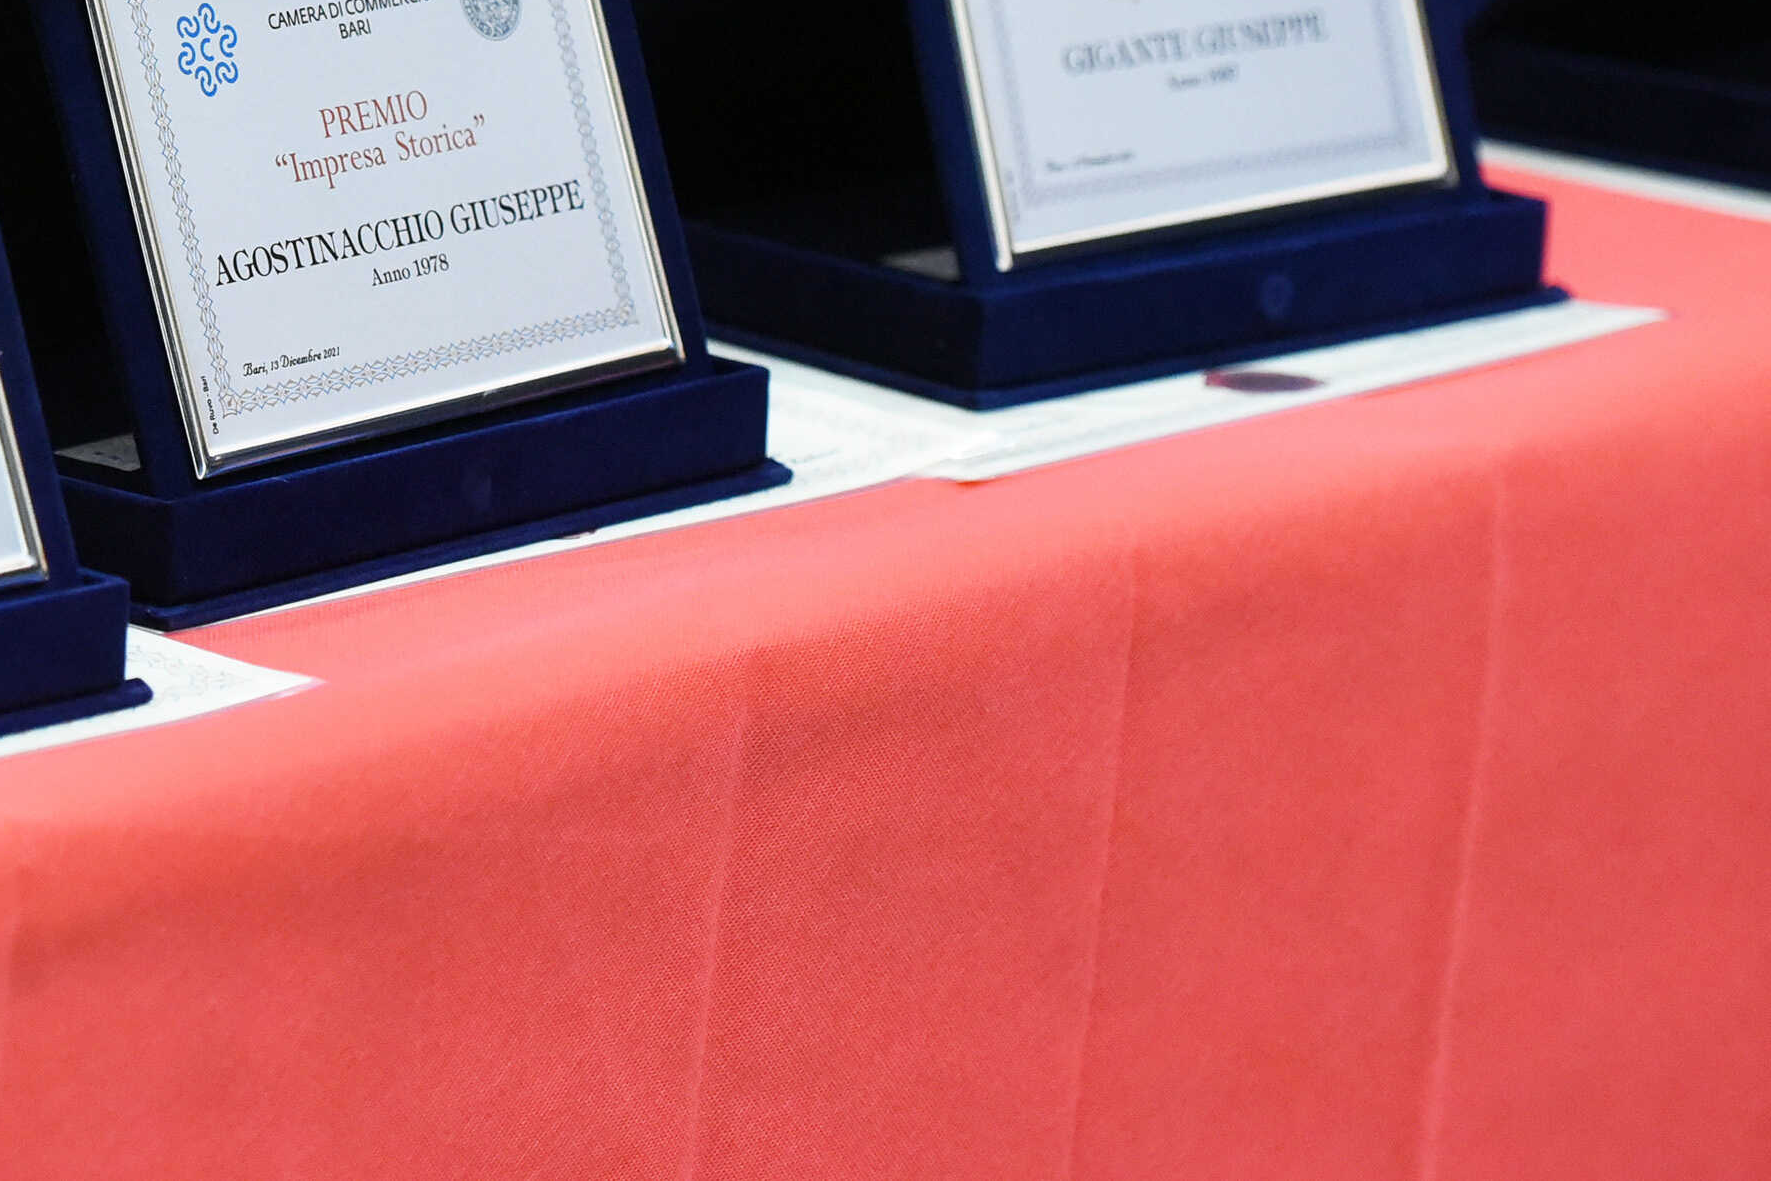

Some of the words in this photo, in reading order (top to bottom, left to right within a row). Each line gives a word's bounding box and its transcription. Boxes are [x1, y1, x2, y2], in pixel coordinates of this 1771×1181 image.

[267, 5, 328, 30] CAMERA
[328, 1, 344, 19] DI
[339, 19, 372, 39] BARI
[319, 90, 428, 138] PREMIO
[275, 146, 387, 189] “Impresa
[395, 114, 485, 161] Storica”
[215, 209, 444, 287] AGOSTINACCHIO
[449, 179, 585, 235] GIUSEPPE
[371, 267, 411, 286] Anno
[413, 253, 450, 277] 1978
[243, 362, 268, 377] Bari,
[280, 348, 321, 368] Dicembre
[323, 346, 340, 360] 2021
